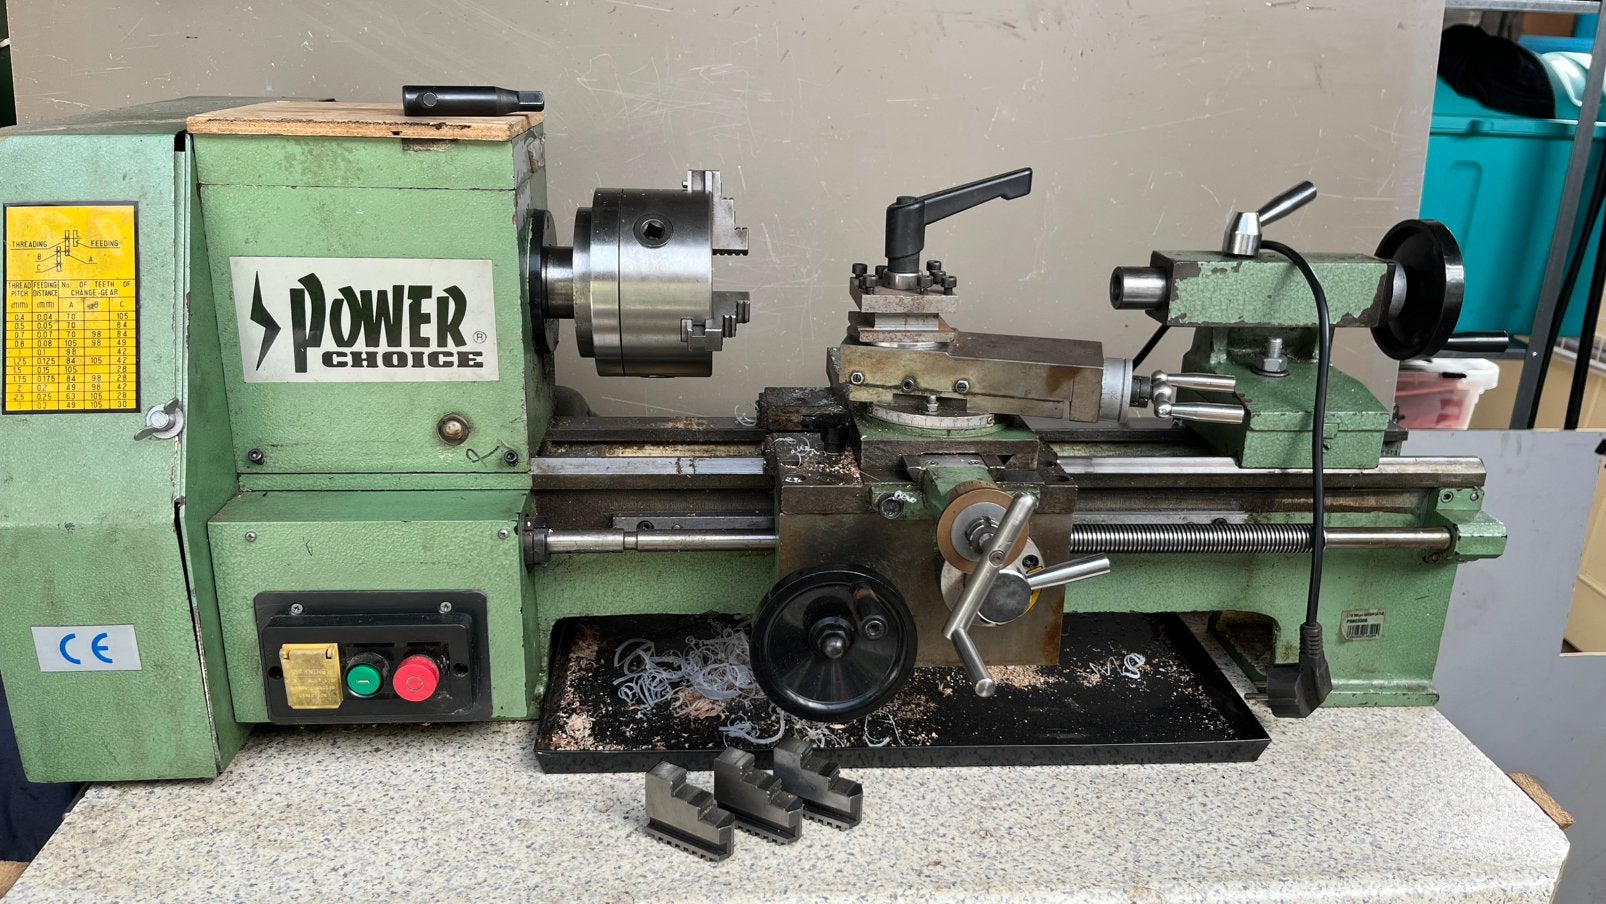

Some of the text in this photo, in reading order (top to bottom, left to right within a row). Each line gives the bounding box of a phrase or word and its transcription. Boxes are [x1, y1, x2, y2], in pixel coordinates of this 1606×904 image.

[8, 281, 32, 289] THREAD
[290, 272, 467, 373] POWER
[322, 351, 484, 368] CHOICE
[59, 632, 113, 664] CE
